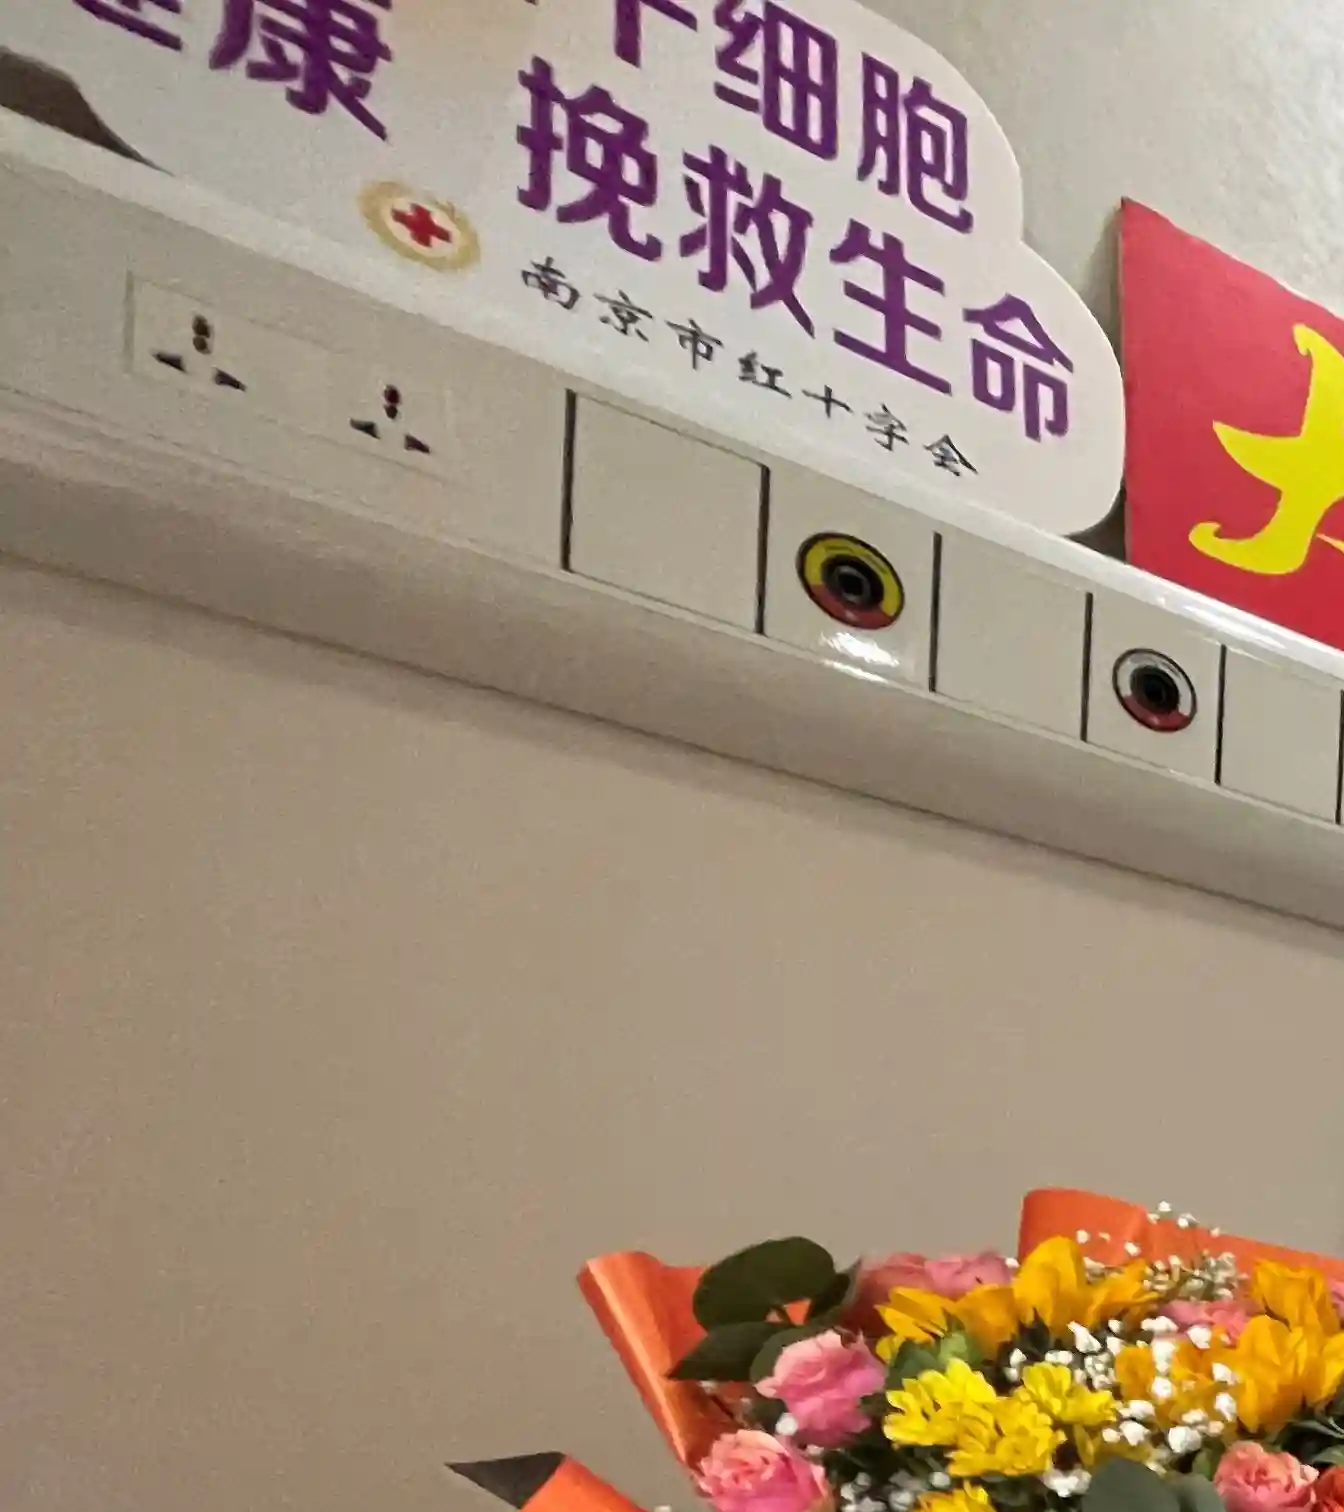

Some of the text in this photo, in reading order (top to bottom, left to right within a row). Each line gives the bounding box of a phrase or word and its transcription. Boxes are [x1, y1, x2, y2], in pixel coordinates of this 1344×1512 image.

[516, 55, 1074, 441] 挽救生命
[520, 255, 979, 477] 南京市红十字会
